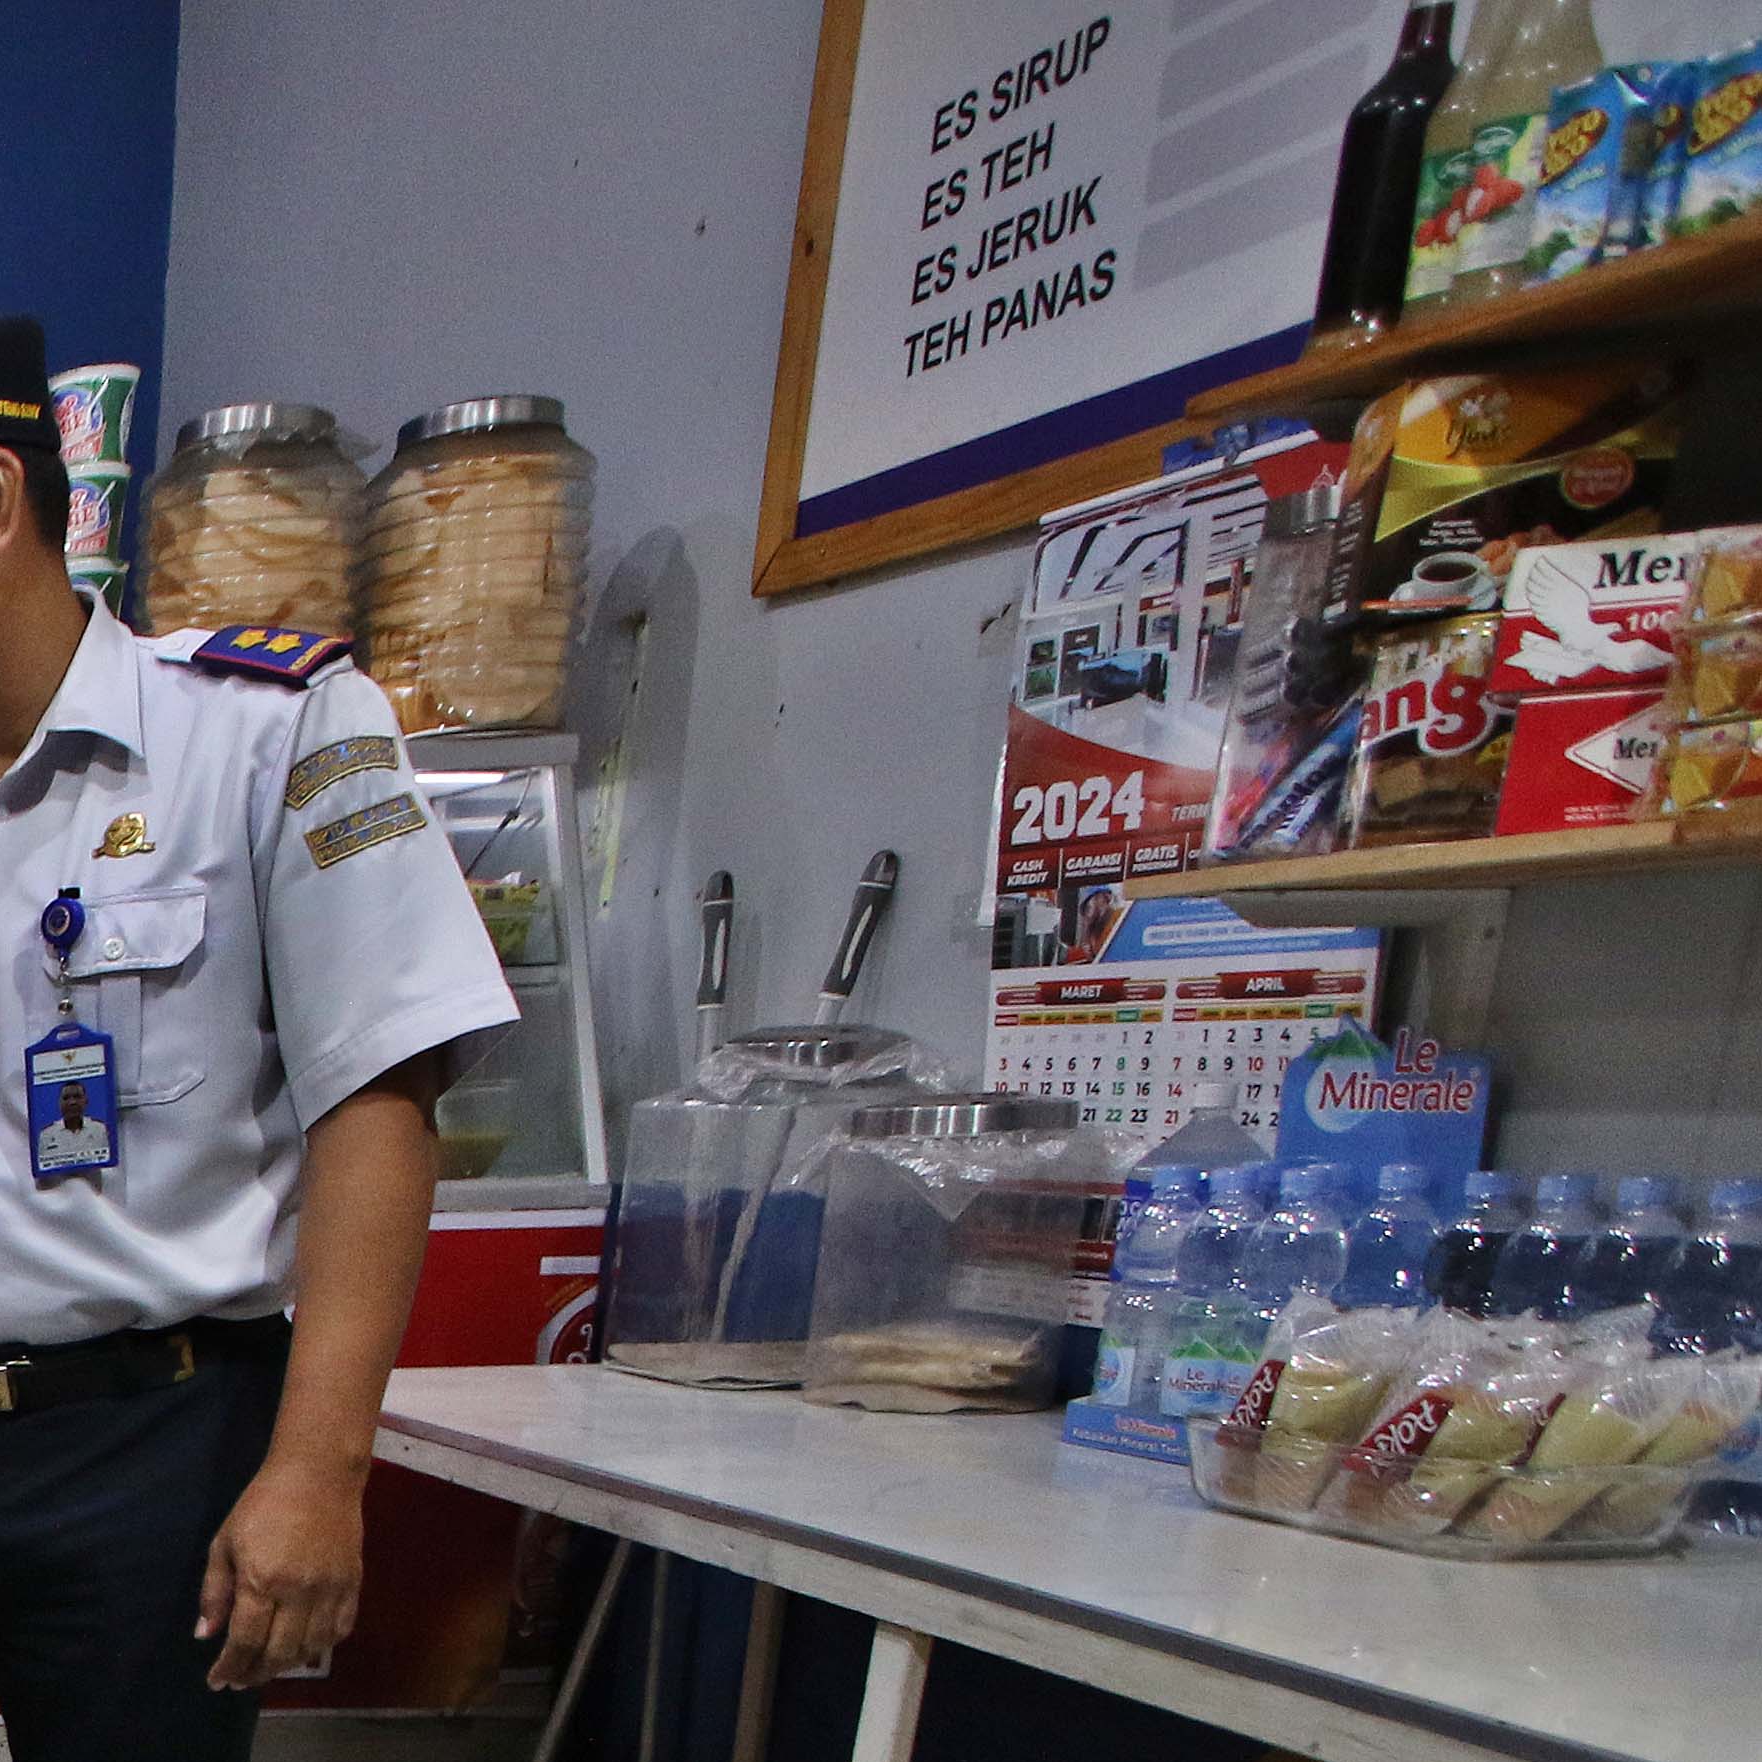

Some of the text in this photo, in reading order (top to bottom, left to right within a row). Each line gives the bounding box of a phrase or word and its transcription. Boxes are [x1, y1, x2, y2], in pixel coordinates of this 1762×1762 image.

[931, 16, 1113, 155] ES SIRUP
[922, 121, 1057, 231] ES TEH
[912, 176, 1103, 306] ES JERUK
[904, 249, 1118, 379] TEH PANAS
[1011, 770, 1145, 846] 2024
[1135, 845, 1179, 862] GRATIS
[1060, 985, 1103, 1000] MARET
[1244, 977, 1285, 993] APRIL
[1122, 1031, 1128, 1044] 1
[1144, 1031, 1153, 1044] 2
[1203, 1029, 1209, 1043] 1
[1227, 1028, 1236, 1043] 2
[1254, 1027, 1262, 1043] 3
[1280, 1028, 1290, 1042] 4
[1395, 1028, 1438, 1075] Le
[999, 1057, 1150, 1071] 3 4 5 6 7 8 9
[1173, 1057, 1181, 1070] 7
[1197, 1057, 1207, 1071] 8
[1224, 1057, 1233, 1071] 9
[1247, 1057, 1264, 1071] 10
[1040, 1082, 1052, 1095] 12
[1062, 1082, 1076, 1095] 13
[1085, 1082, 1101, 1095] 14
[1112, 1082, 1124, 1096] 15
[1136, 1082, 1150, 1096] 16
[1167, 1083, 1182, 1097] 14
[1246, 1084, 1261, 1098] 17
[1318, 1069, 1475, 1113] Minerale
[1082, 1109, 1148, 1123] 21 22 23
[1164, 1110, 1179, 1124] 21
[1241, 1112, 1260, 1126] 24
